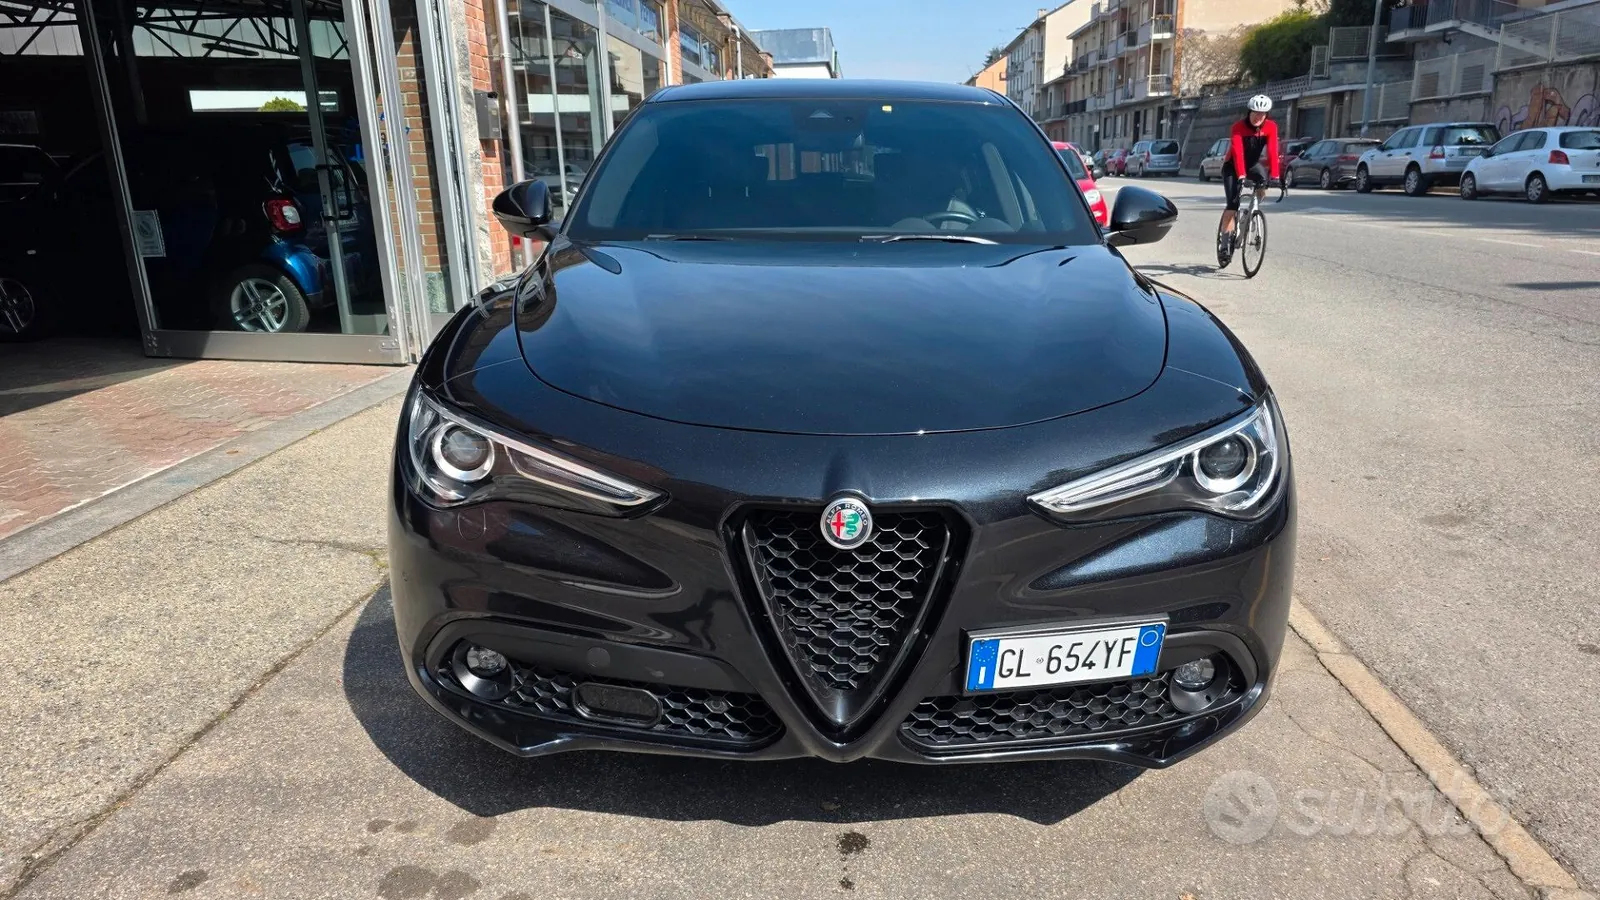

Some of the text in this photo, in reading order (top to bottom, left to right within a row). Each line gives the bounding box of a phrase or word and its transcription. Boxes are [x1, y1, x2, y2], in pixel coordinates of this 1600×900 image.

[826, 505, 841, 524] ALFA
[998, 636, 1137, 679] GL 654YF
[978, 666, 987, 684] I
